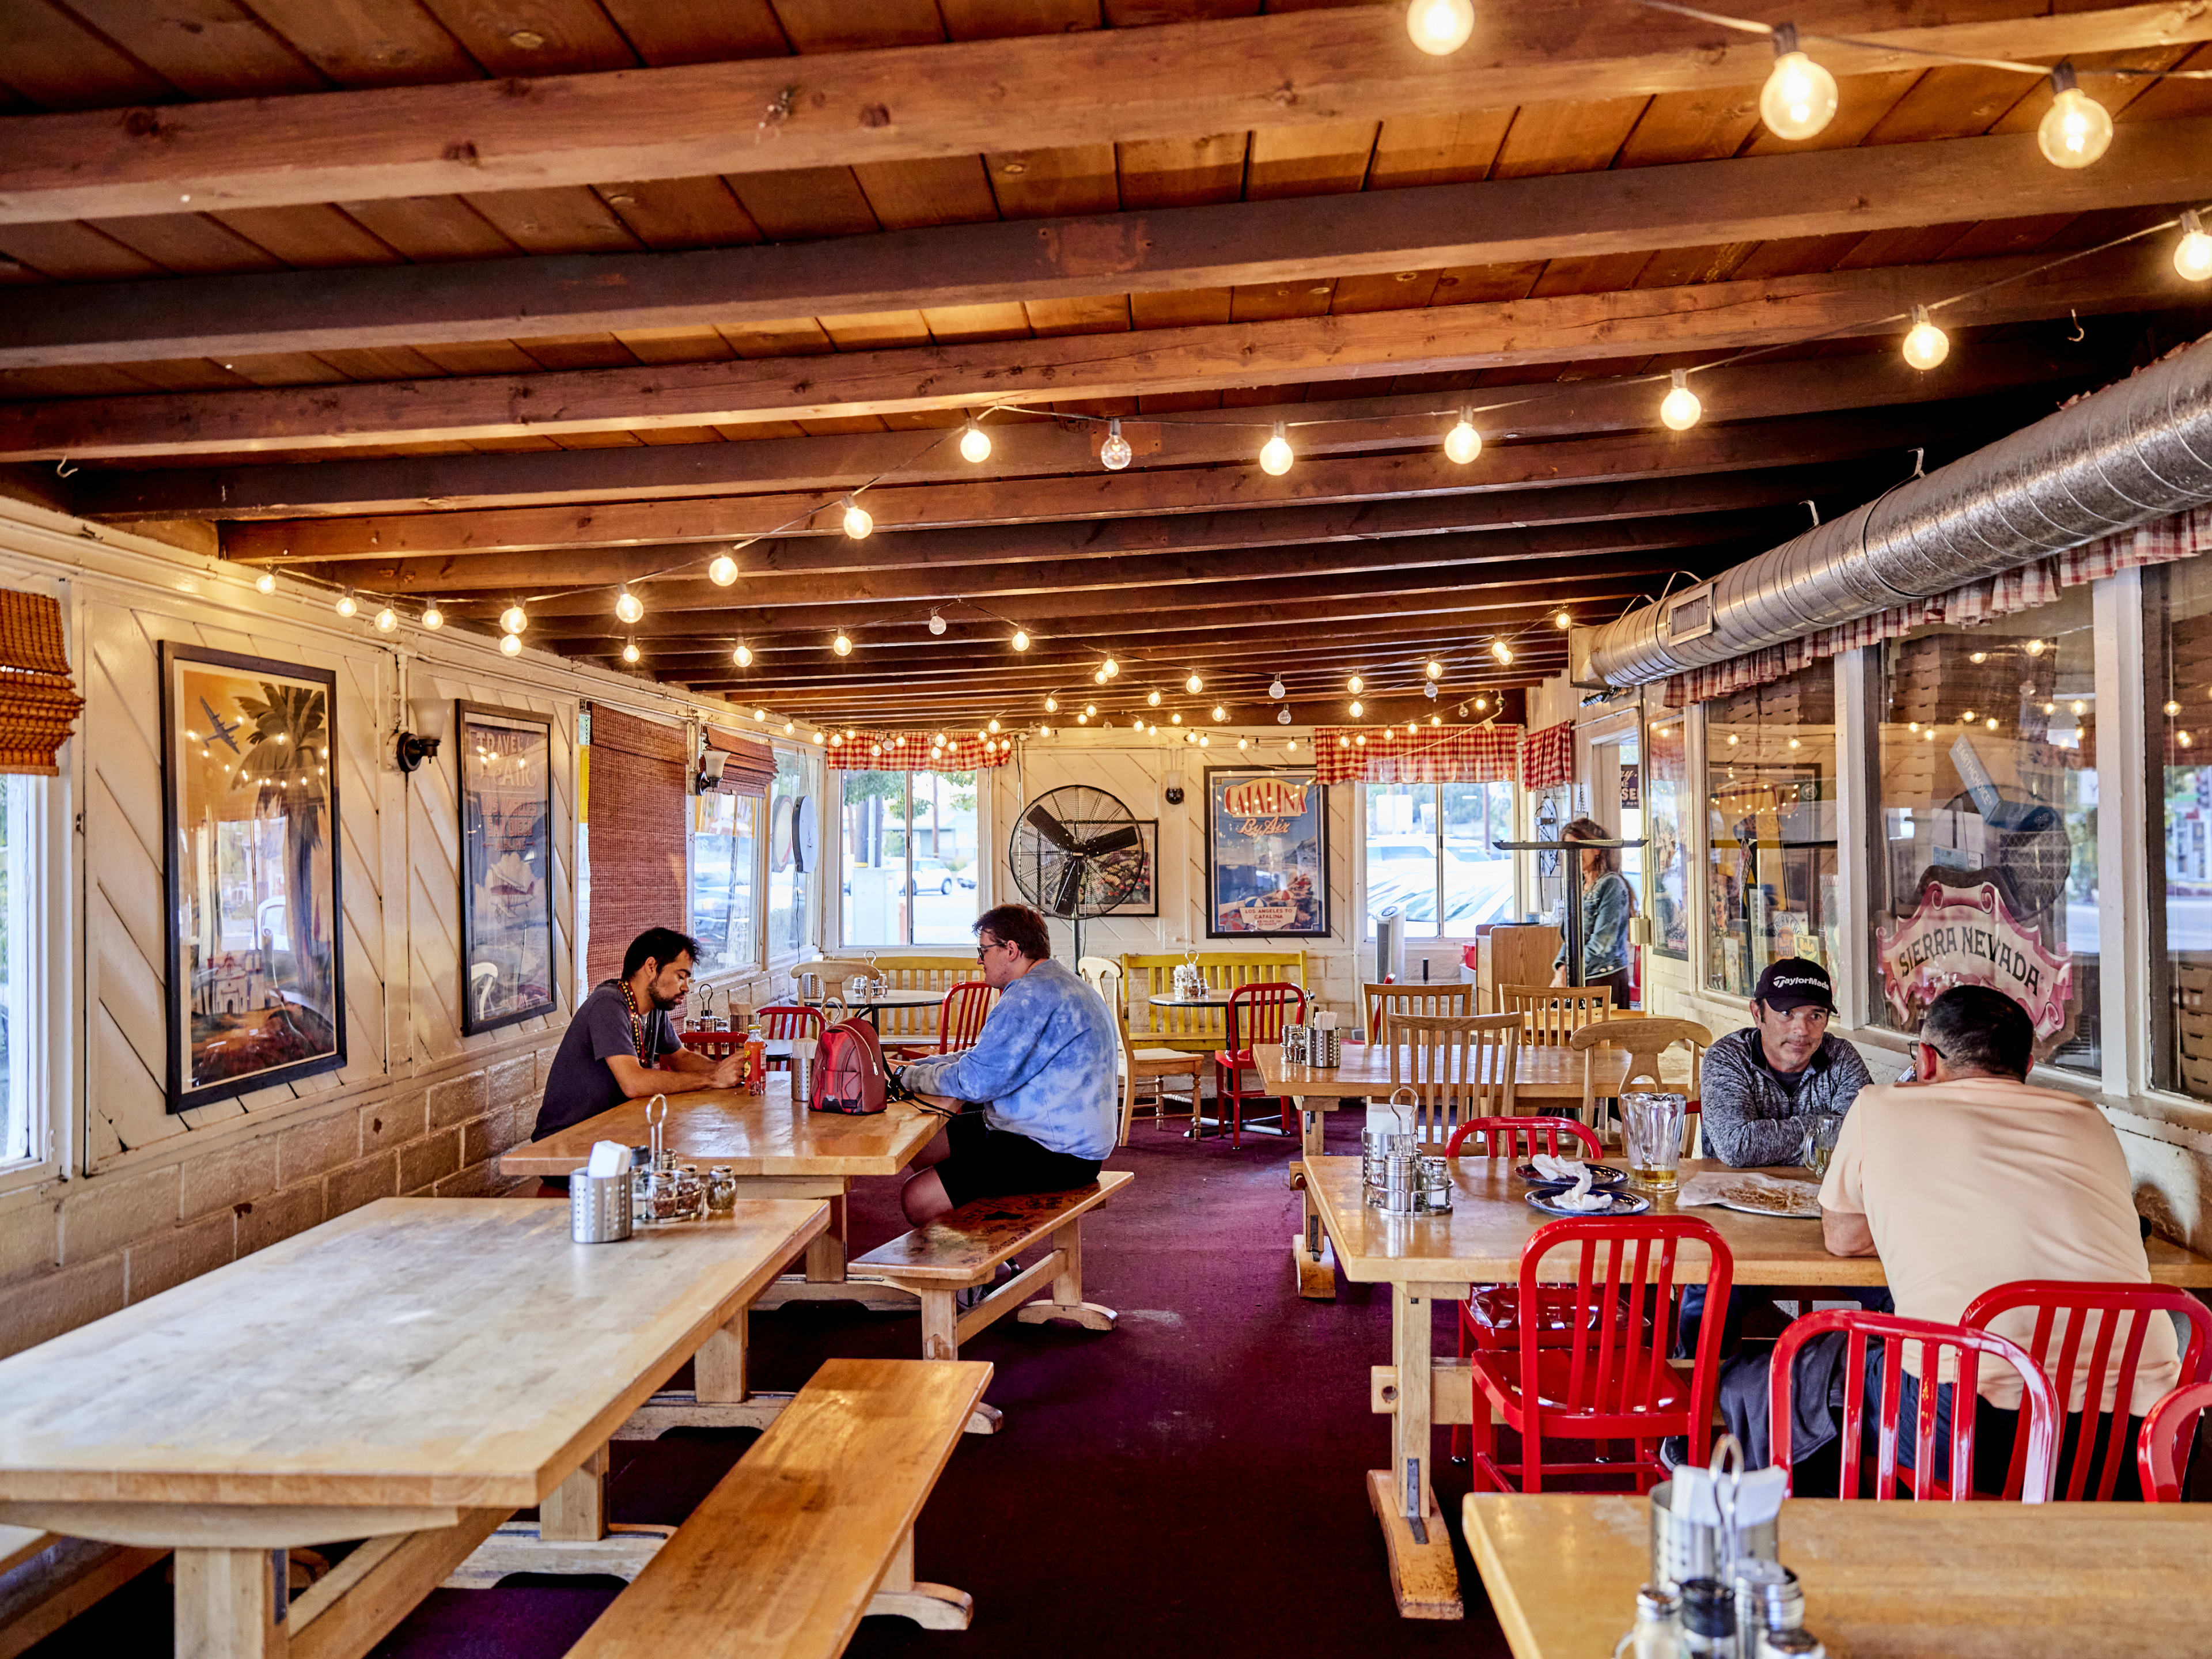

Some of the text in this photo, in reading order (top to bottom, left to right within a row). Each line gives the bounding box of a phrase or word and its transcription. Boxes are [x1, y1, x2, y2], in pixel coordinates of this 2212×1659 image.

[476, 731, 524, 758] TRAVEL
[1956, 743, 1991, 805] EARTHCHOICE
[481, 796, 537, 816] LOS ANGELES
[1225, 782, 1308, 815] CATALINA
[487, 817, 533, 837] SAN DIEGO
[1237, 815, 1291, 844] By Air
[495, 838, 526, 851] AIRLINE
[1899, 926, 2040, 997] SIERRA NEVADA
[1773, 976, 1830, 990] TaylorMade
